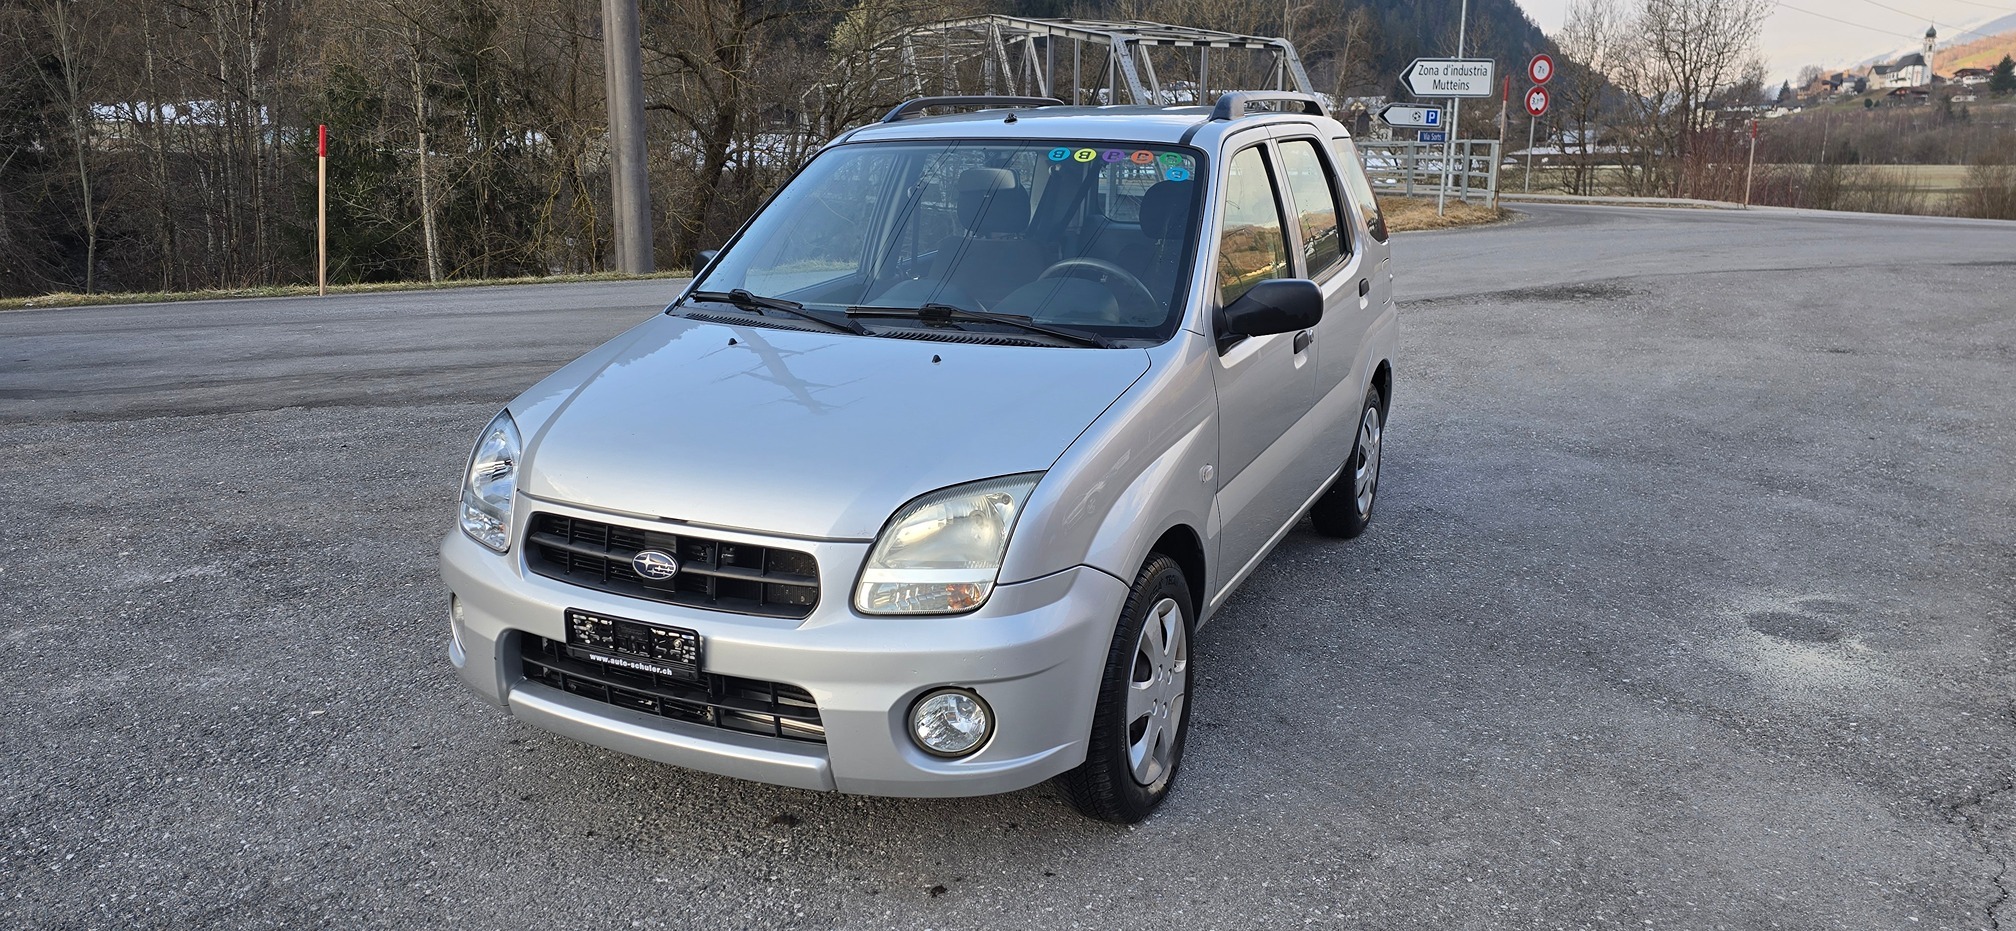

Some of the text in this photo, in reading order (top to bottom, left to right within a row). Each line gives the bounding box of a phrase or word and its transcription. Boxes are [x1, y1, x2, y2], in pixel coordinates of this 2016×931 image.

[1418, 64, 1488, 77] Zona d'industria
[1432, 79, 1470, 91] Mutteins
[1428, 111, 1436, 123] P
[1423, 132, 1431, 141] Via
[589, 653, 673, 676] www.auto-schuler.ch
